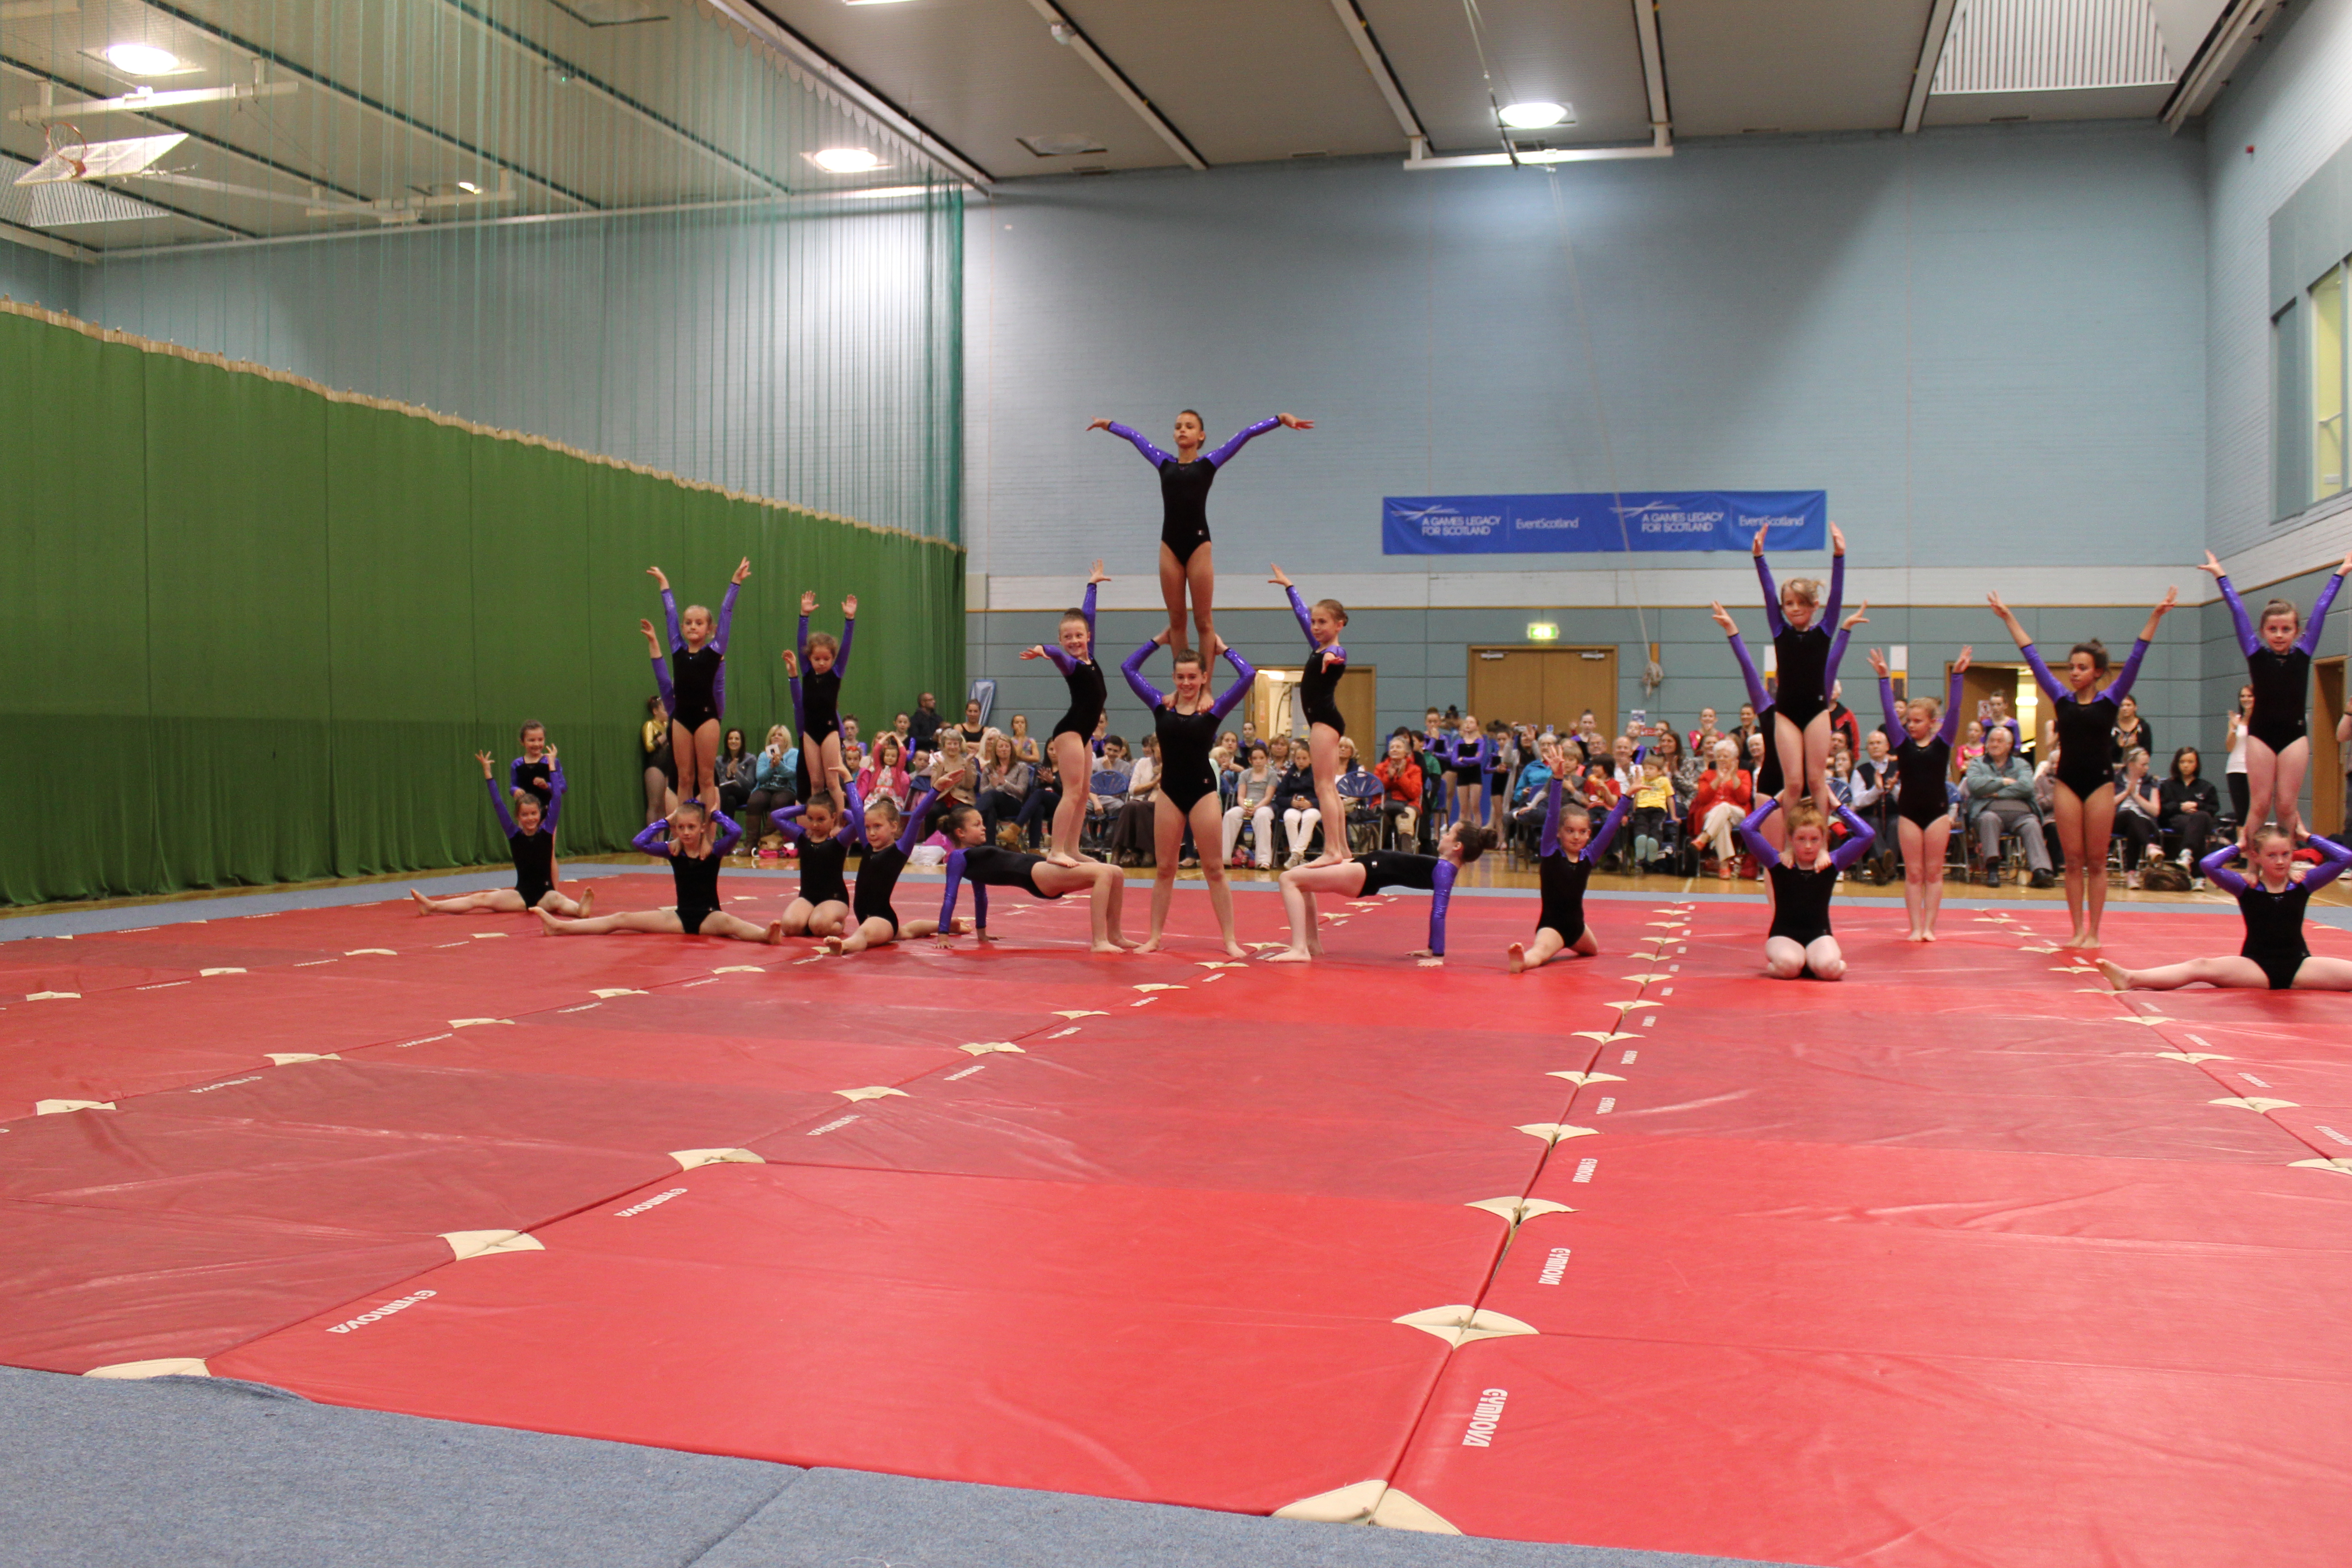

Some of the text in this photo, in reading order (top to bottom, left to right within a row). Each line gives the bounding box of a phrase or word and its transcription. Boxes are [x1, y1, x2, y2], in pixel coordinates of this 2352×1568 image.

[1422, 515, 1501, 526] A GAMES LEGACY
[1642, 511, 1724, 522] A GAMES LEGACY
[1422, 525, 1491, 536] FOR SCOTLAND
[1642, 522, 1713, 533] FOR SCOTLAND
[613, 1188, 688, 1217] GYMNOVA
[1538, 1248, 1571, 1285] GYMNOVA
[325, 1290, 437, 1333] GYMNOVA
[1462, 1388, 1508, 1447] GYMNOVA
